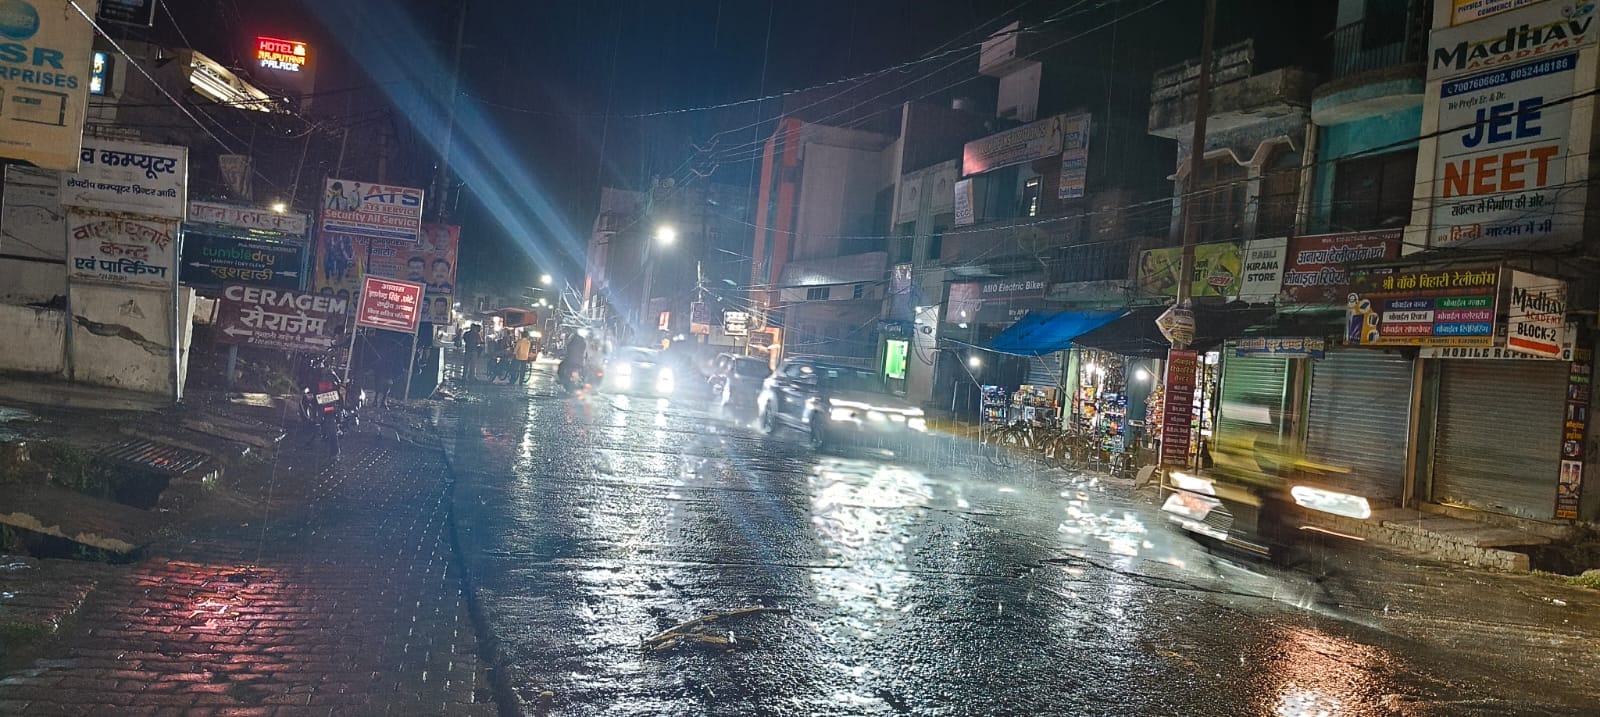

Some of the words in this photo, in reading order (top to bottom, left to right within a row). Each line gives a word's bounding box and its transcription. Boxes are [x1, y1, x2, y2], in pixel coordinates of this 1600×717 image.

[260, 40, 292, 53] HOTEL
[1467, 35, 1586, 70] ACADEMY
[258, 50, 305, 65] RAJPUTANA
[261, 59, 299, 71] PALACE
[1462, 96, 1544, 148] JEE
[100, 149, 178, 180] कम्प्यूटर
[1443, 145, 1559, 198] NEET
[364, 184, 420, 206] ATS
[1515, 194, 1526, 209] की
[367, 215, 381, 225] All
[383, 216, 418, 227] Service
[1450, 223, 1482, 242] हिन्दी
[74, 255, 97, 270] एवं
[202, 246, 275, 266] tumbledry
[1246, 262, 1279, 271] KIRANA
[1247, 272, 1276, 282] STORE
[998, 281, 1024, 292] Electric
[1025, 280, 1044, 290] Bikes
[224, 286, 347, 314] CERAGEM
[240, 305, 327, 336] सेराजेम
[1517, 322, 1556, 342] BLOCK-2
[1442, 347, 1490, 358] MOBILE
